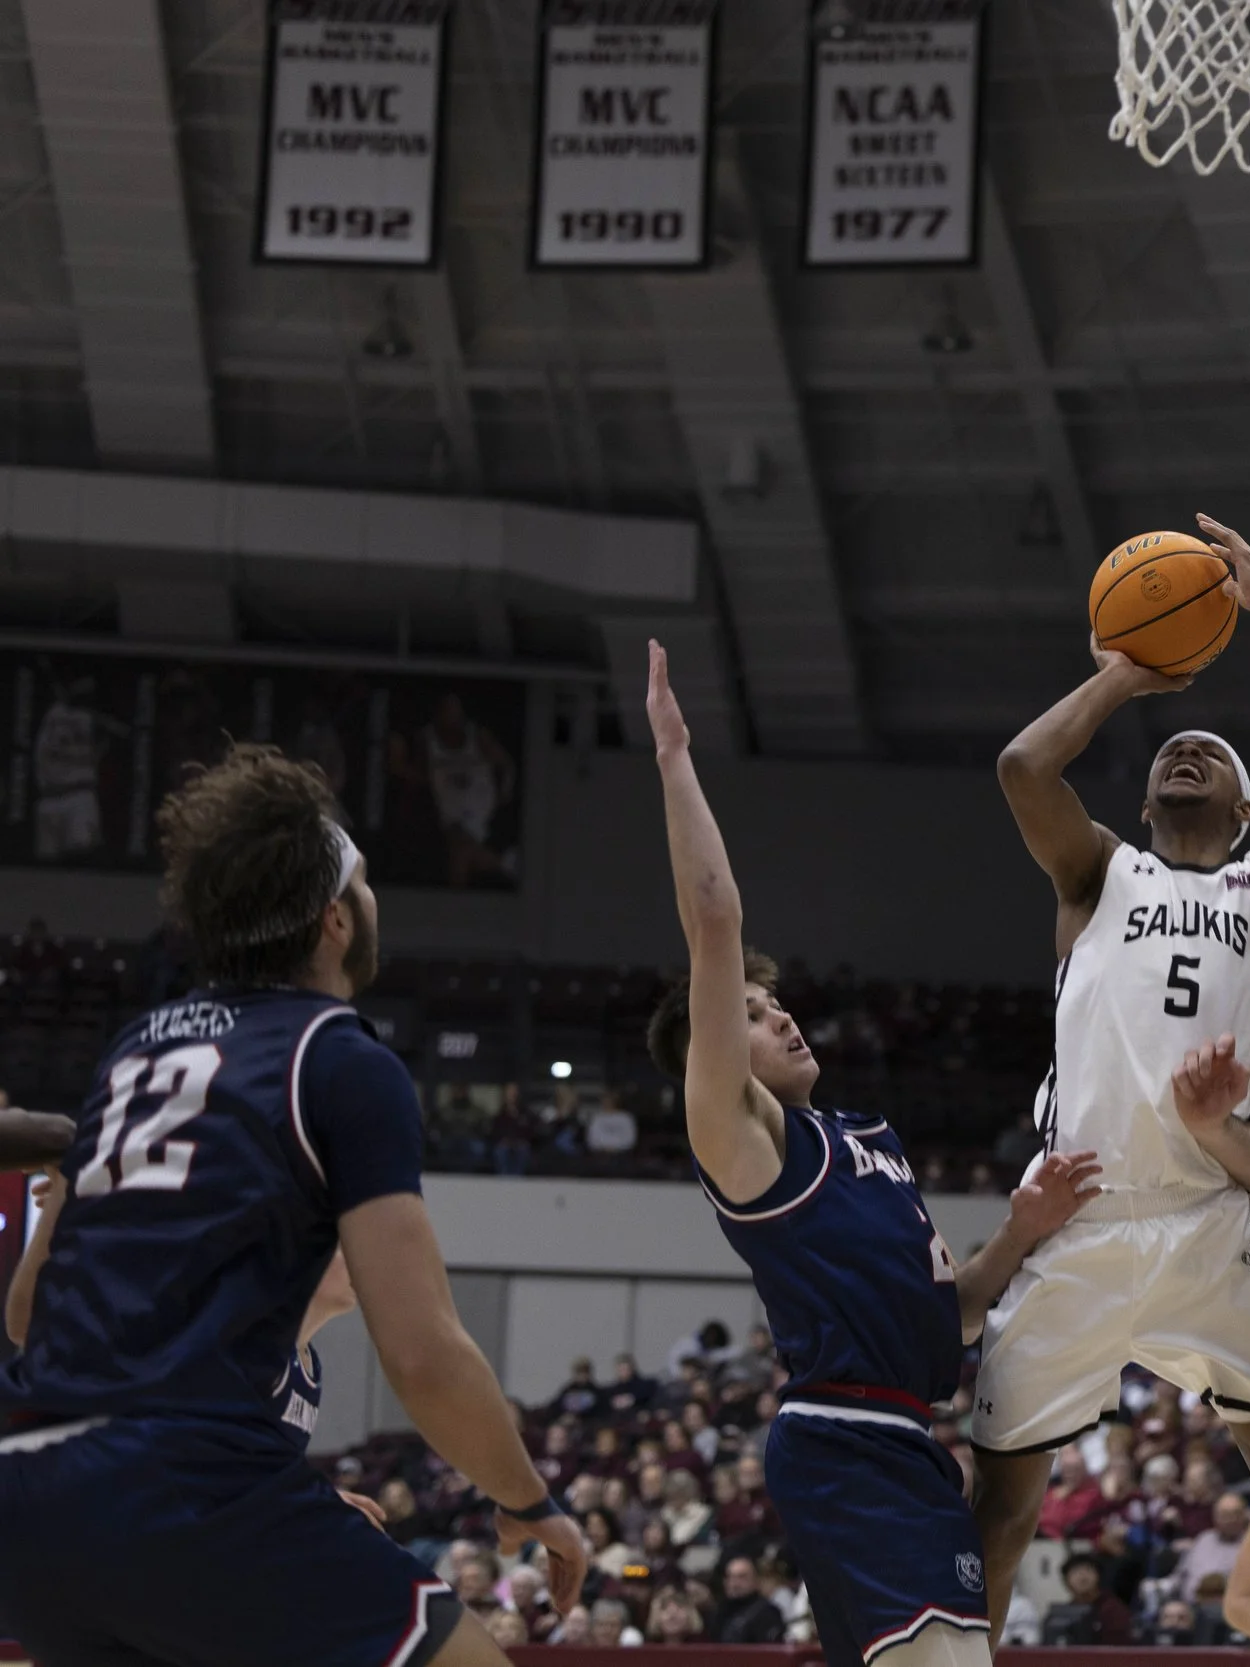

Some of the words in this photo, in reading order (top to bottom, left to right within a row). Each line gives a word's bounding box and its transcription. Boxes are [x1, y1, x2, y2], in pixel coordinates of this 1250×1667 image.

[307, 83, 402, 125] MVC
[579, 84, 672, 126] MVC
[832, 83, 956, 125] NCAA
[276, 129, 428, 157] CHAMPIONS
[550, 132, 697, 159] CHAMPIONS
[850, 130, 937, 158] SWEET
[834, 163, 949, 190] SIXTEEN
[287, 205, 414, 242] 1992
[559, 207, 684, 243] 1990
[832, 205, 952, 241] 1977
[1163, 953, 1201, 1018] 5
[74, 1041, 224, 1200] 12
